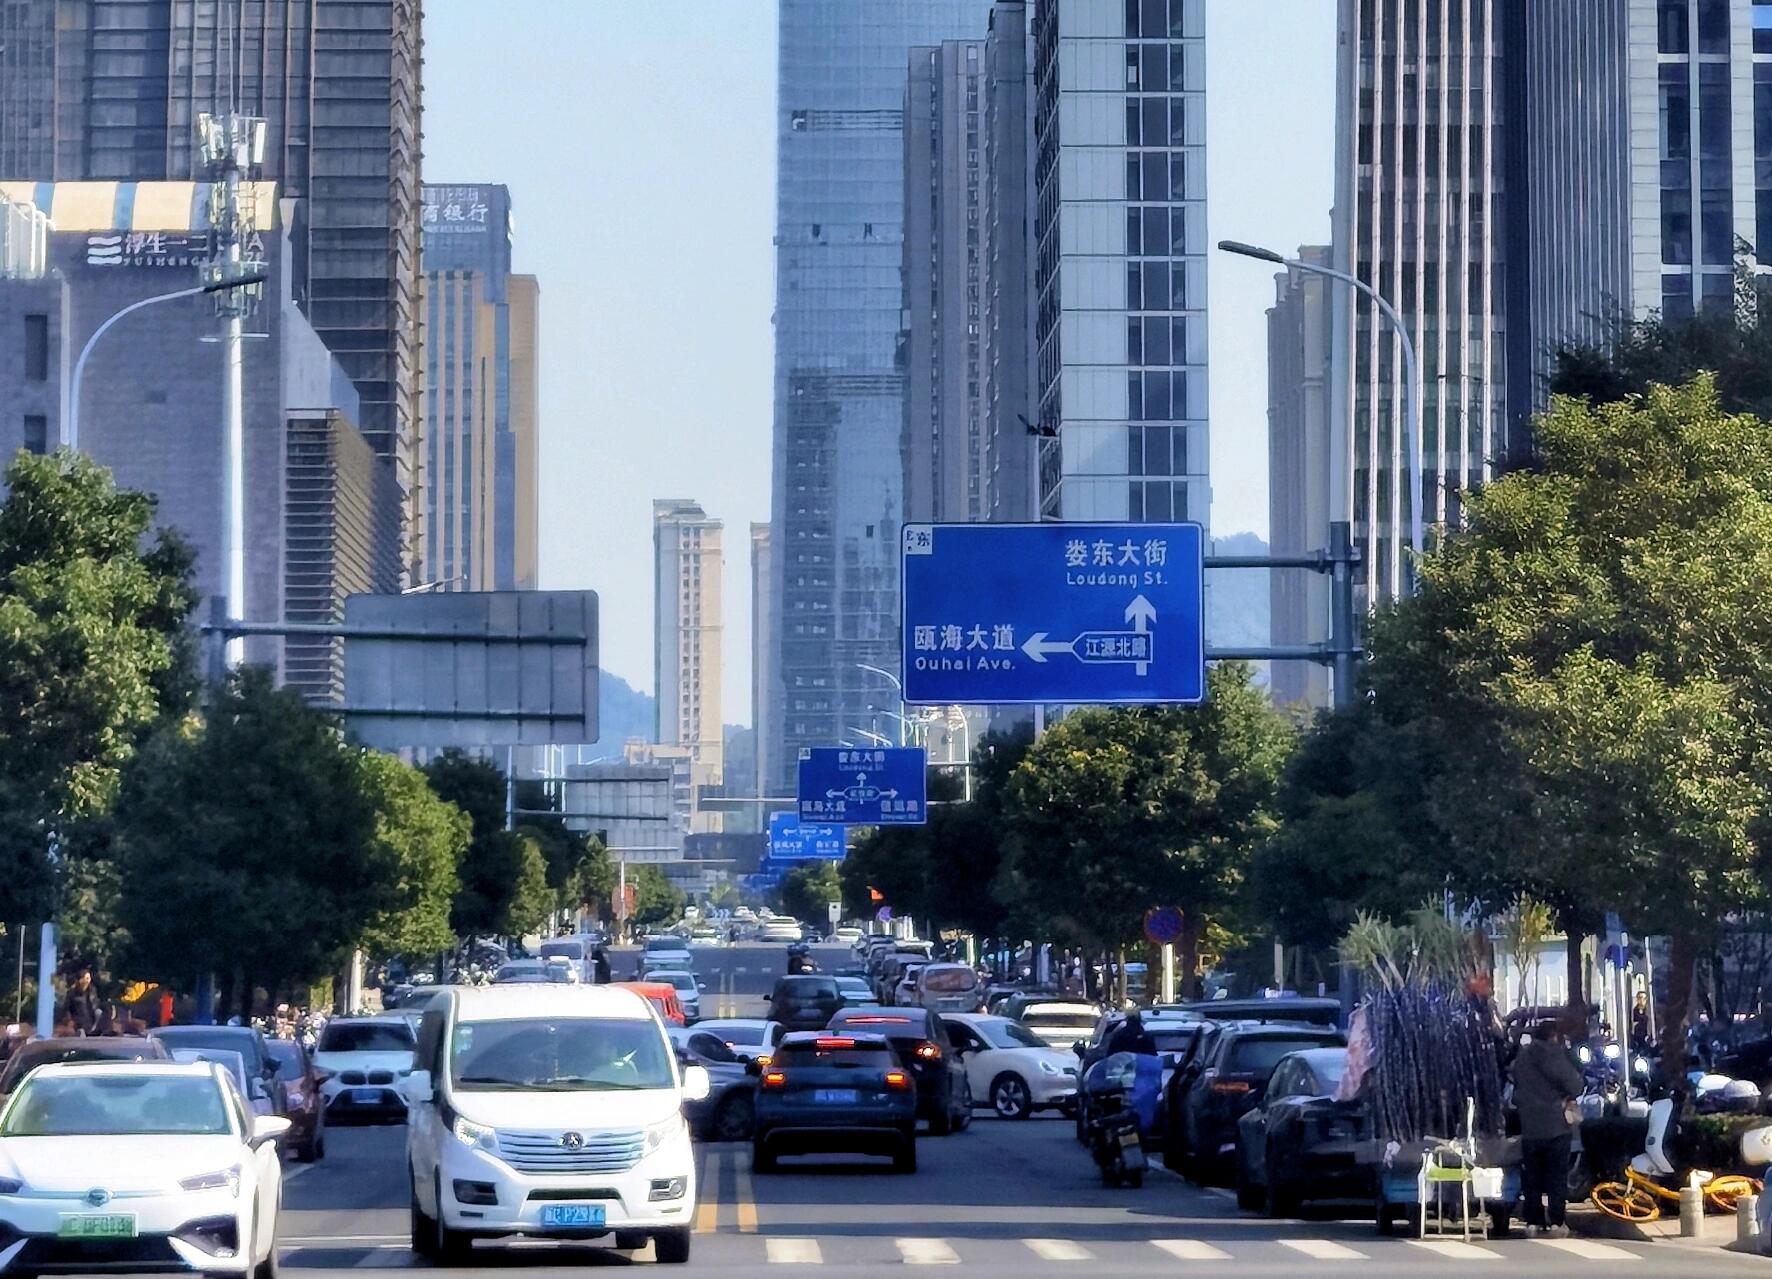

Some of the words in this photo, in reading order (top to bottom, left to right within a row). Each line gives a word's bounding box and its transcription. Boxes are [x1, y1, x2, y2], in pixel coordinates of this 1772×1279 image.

[1065, 538, 1167, 567] 娄东大街
[1066, 571, 1138, 589] Loudong
[1143, 571, 1168, 585] St.
[914, 623, 1016, 651] 瓯海大道
[976, 656, 1016, 670] Ave.
